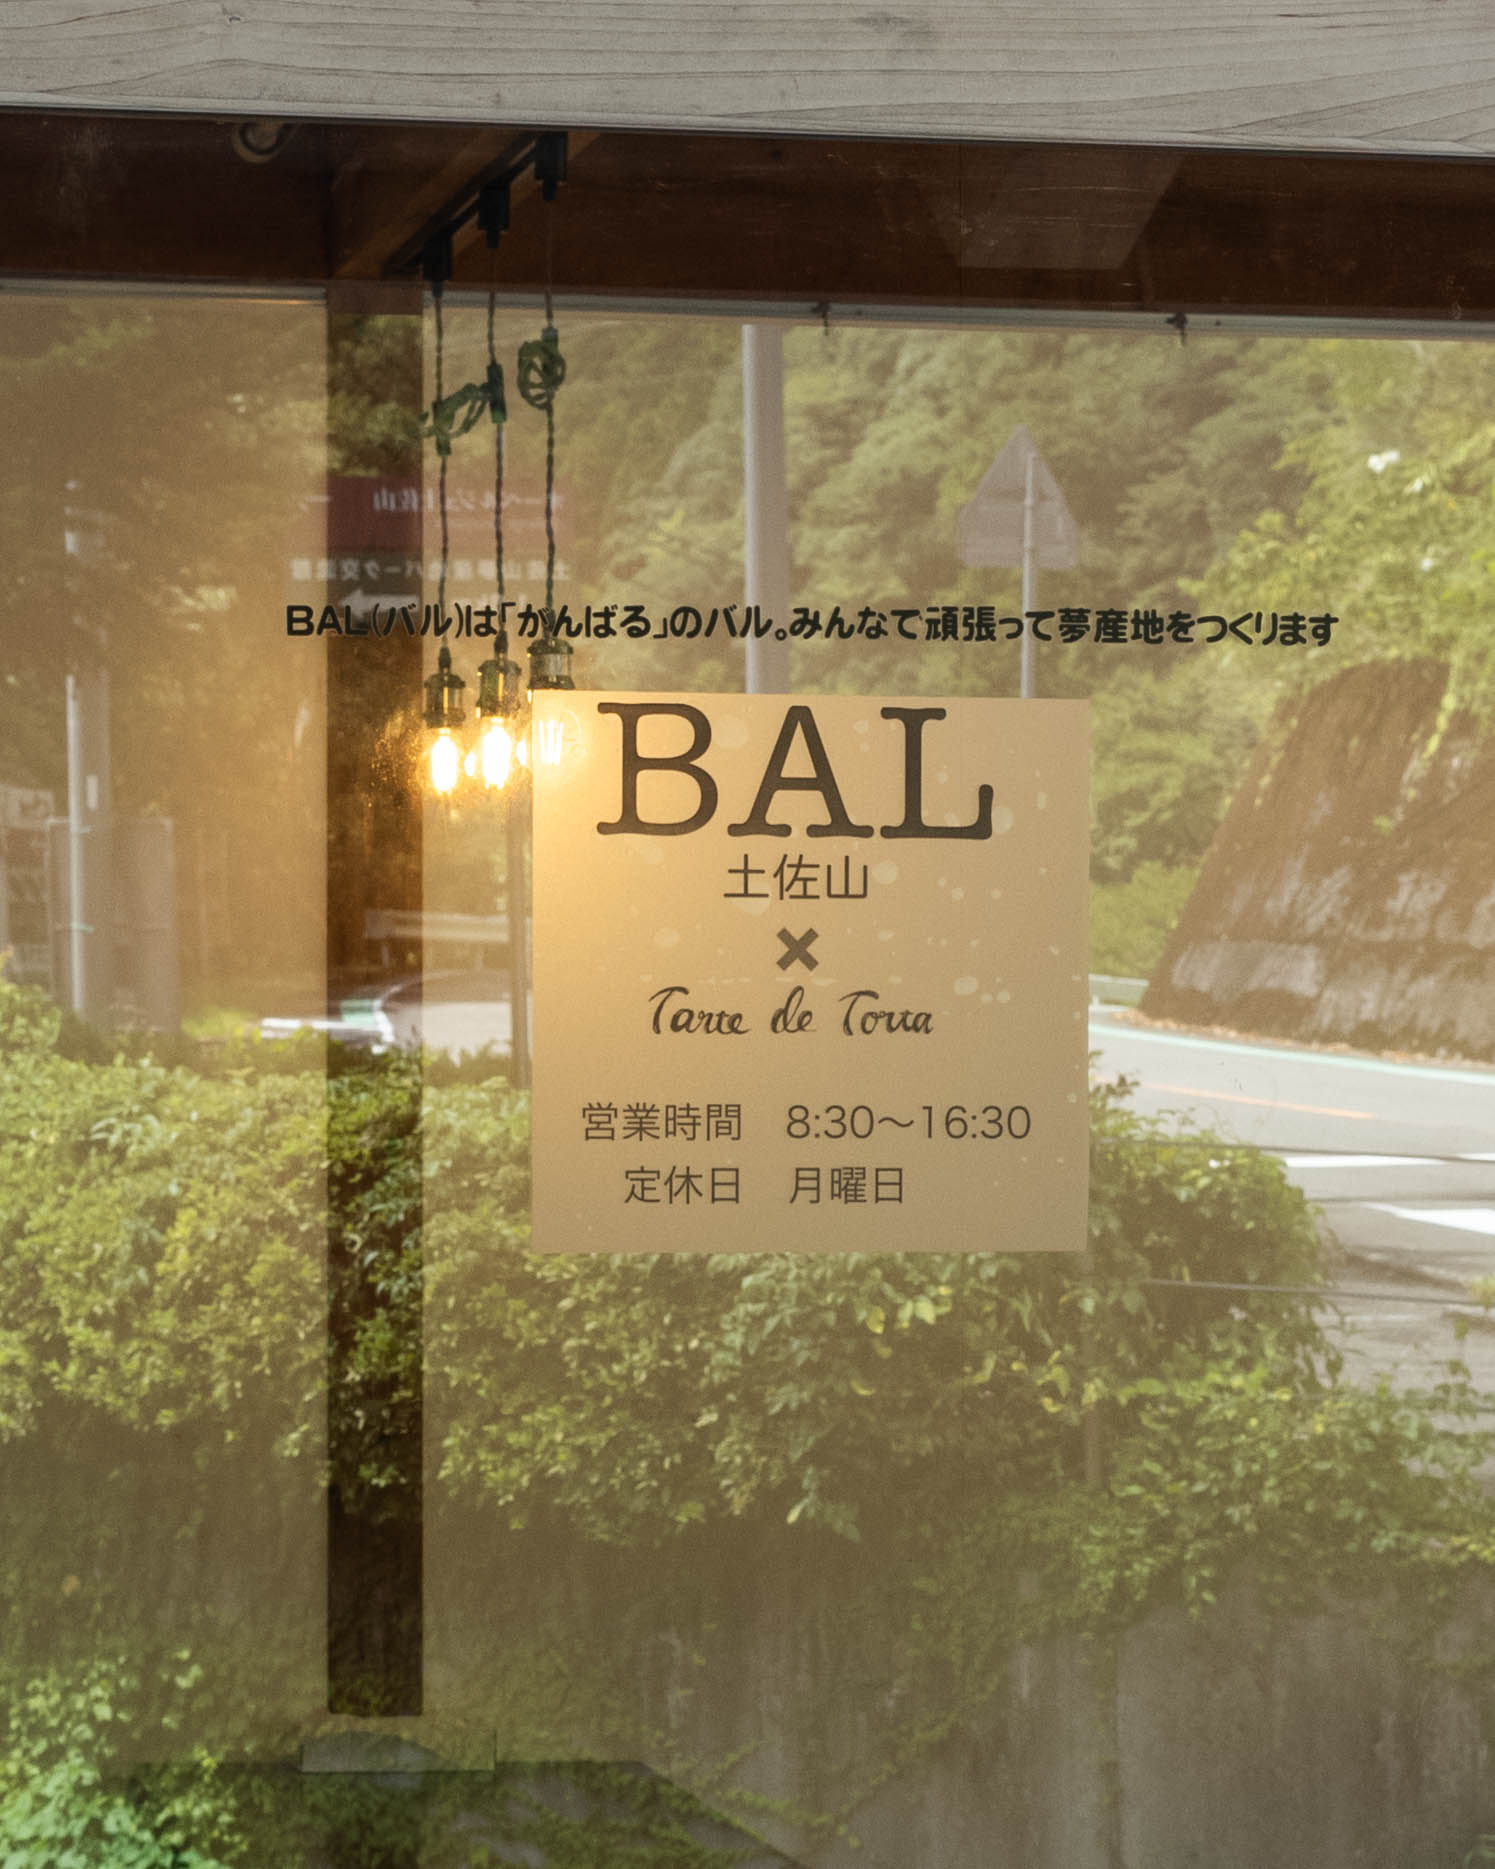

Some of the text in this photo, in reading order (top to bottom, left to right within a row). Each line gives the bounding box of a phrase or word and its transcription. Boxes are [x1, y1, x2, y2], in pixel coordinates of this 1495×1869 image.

[596, 701, 994, 840] BAL
[723, 854, 868, 900] 土佐山
[770, 985, 817, 1034] de
[581, 1101, 742, 1142] 営業時間
[623, 1165, 903, 1205] 定休日 月曜日
